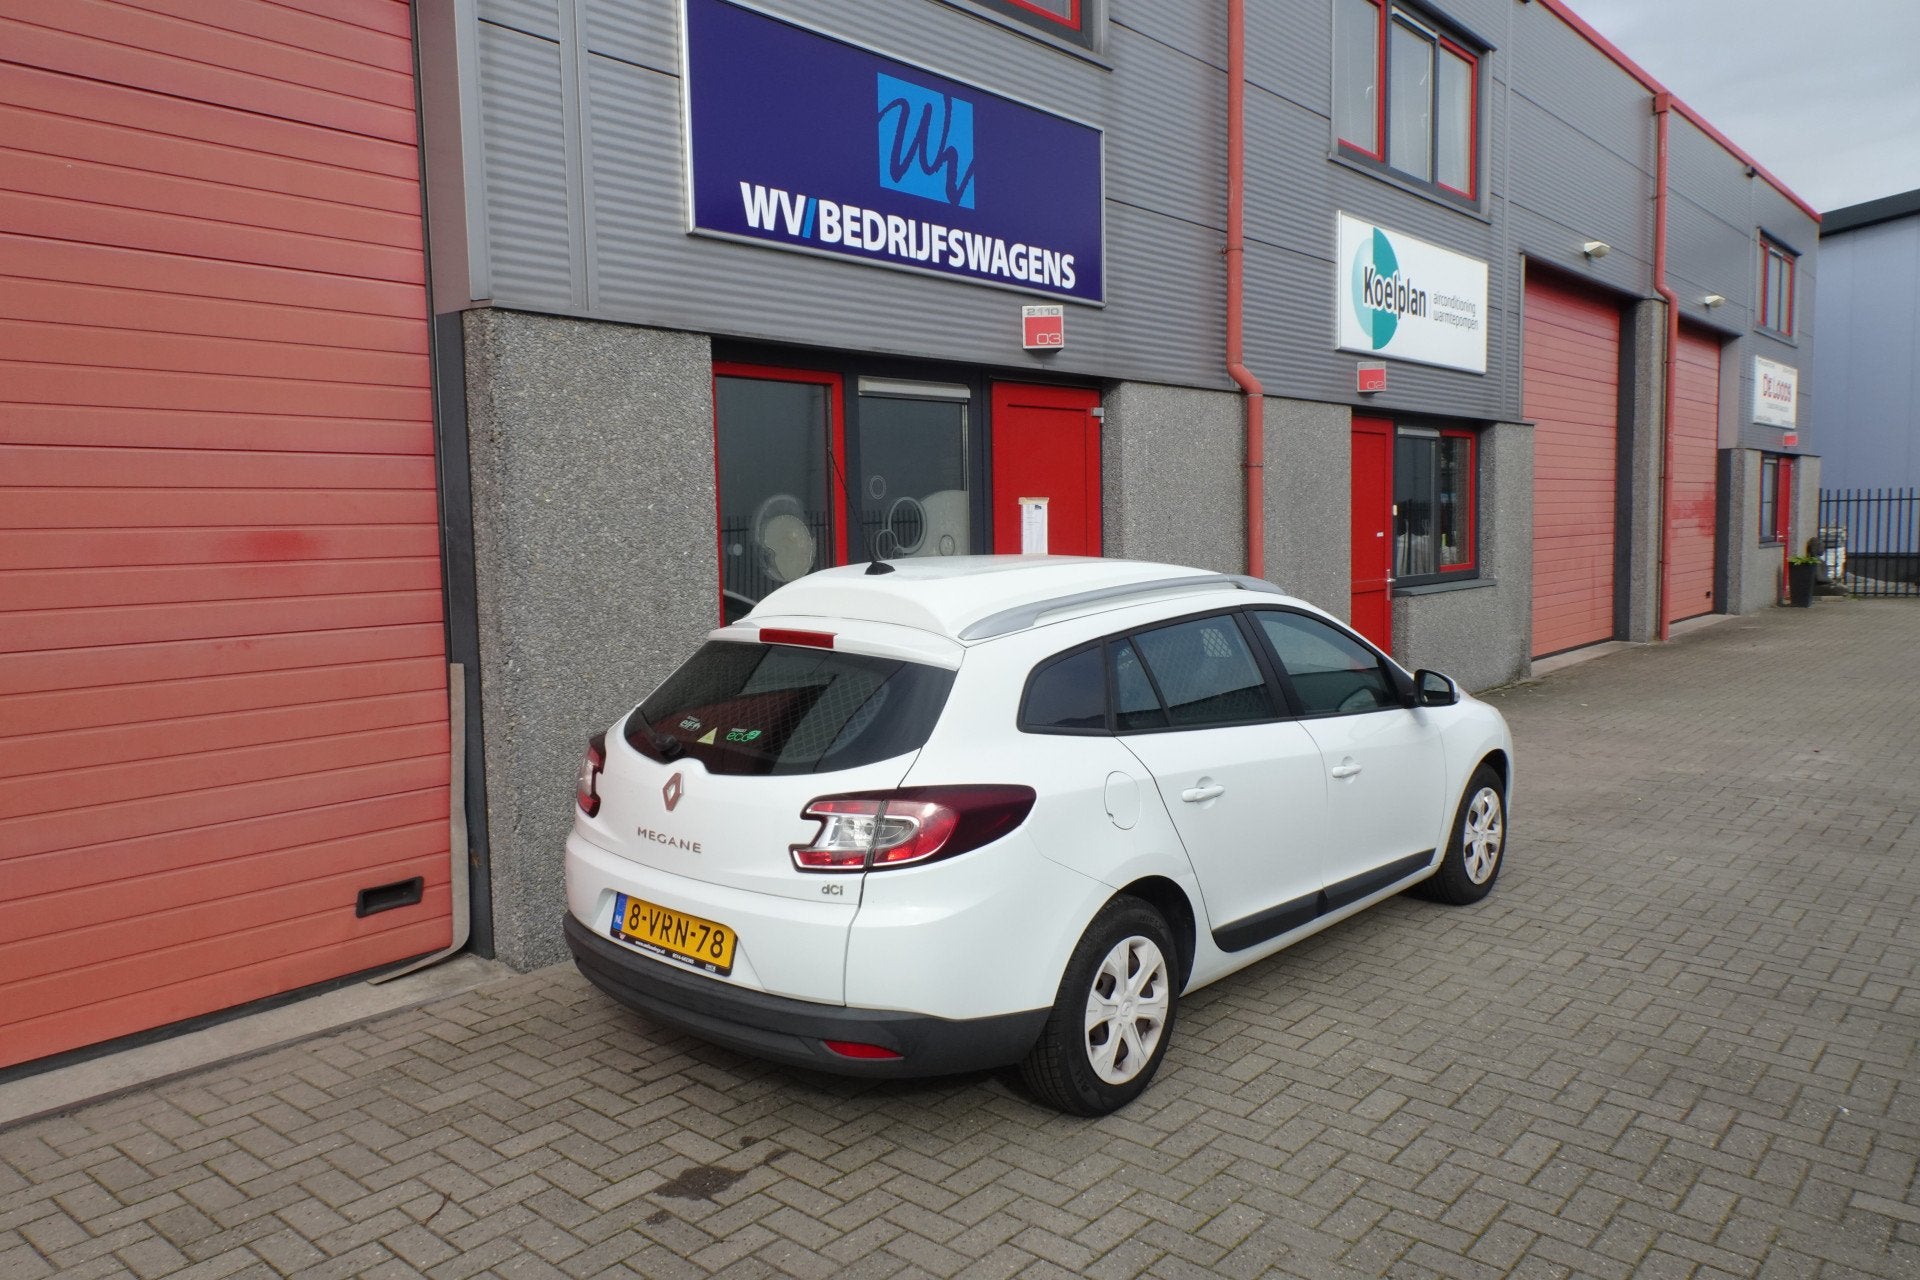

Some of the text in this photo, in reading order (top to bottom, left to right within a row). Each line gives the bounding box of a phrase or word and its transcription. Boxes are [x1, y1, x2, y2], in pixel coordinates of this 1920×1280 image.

[1364, 266, 1426, 320] Koelplan
[1433, 291, 1476, 317] airconditioning
[1037, 333, 1061, 344] 03
[637, 826, 702, 854] MEGANE
[822, 884, 843, 896] dCi
[629, 903, 725, 959] 8-VRN-78
